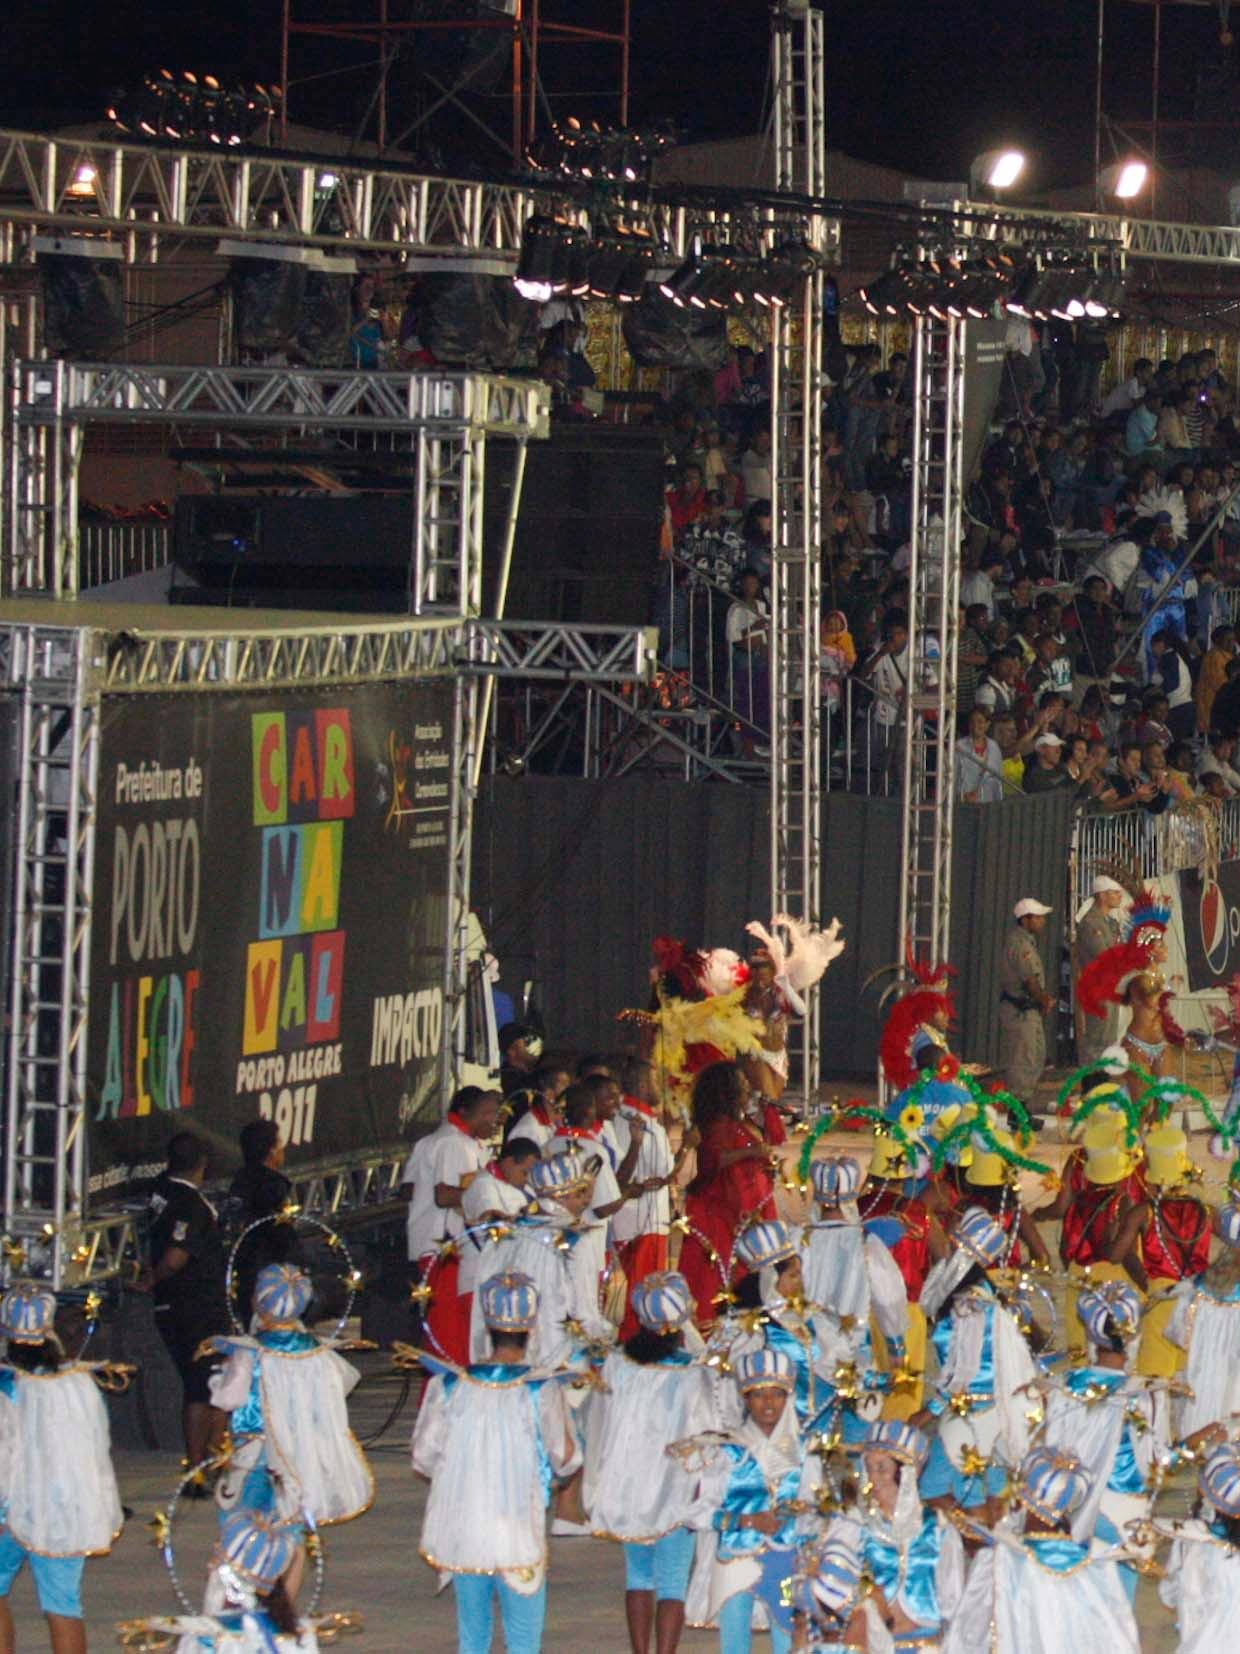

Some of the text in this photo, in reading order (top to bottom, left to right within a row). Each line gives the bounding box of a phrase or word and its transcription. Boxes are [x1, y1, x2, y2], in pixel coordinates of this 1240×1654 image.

[116, 757, 203, 805] Prefeitura de
[110, 817, 199, 966] PORTO
[96, 970, 200, 1120] ALEGRE
[370, 987, 442, 1068] IMPACTO
[236, 1044, 343, 1094] PORTO ALEGRE
